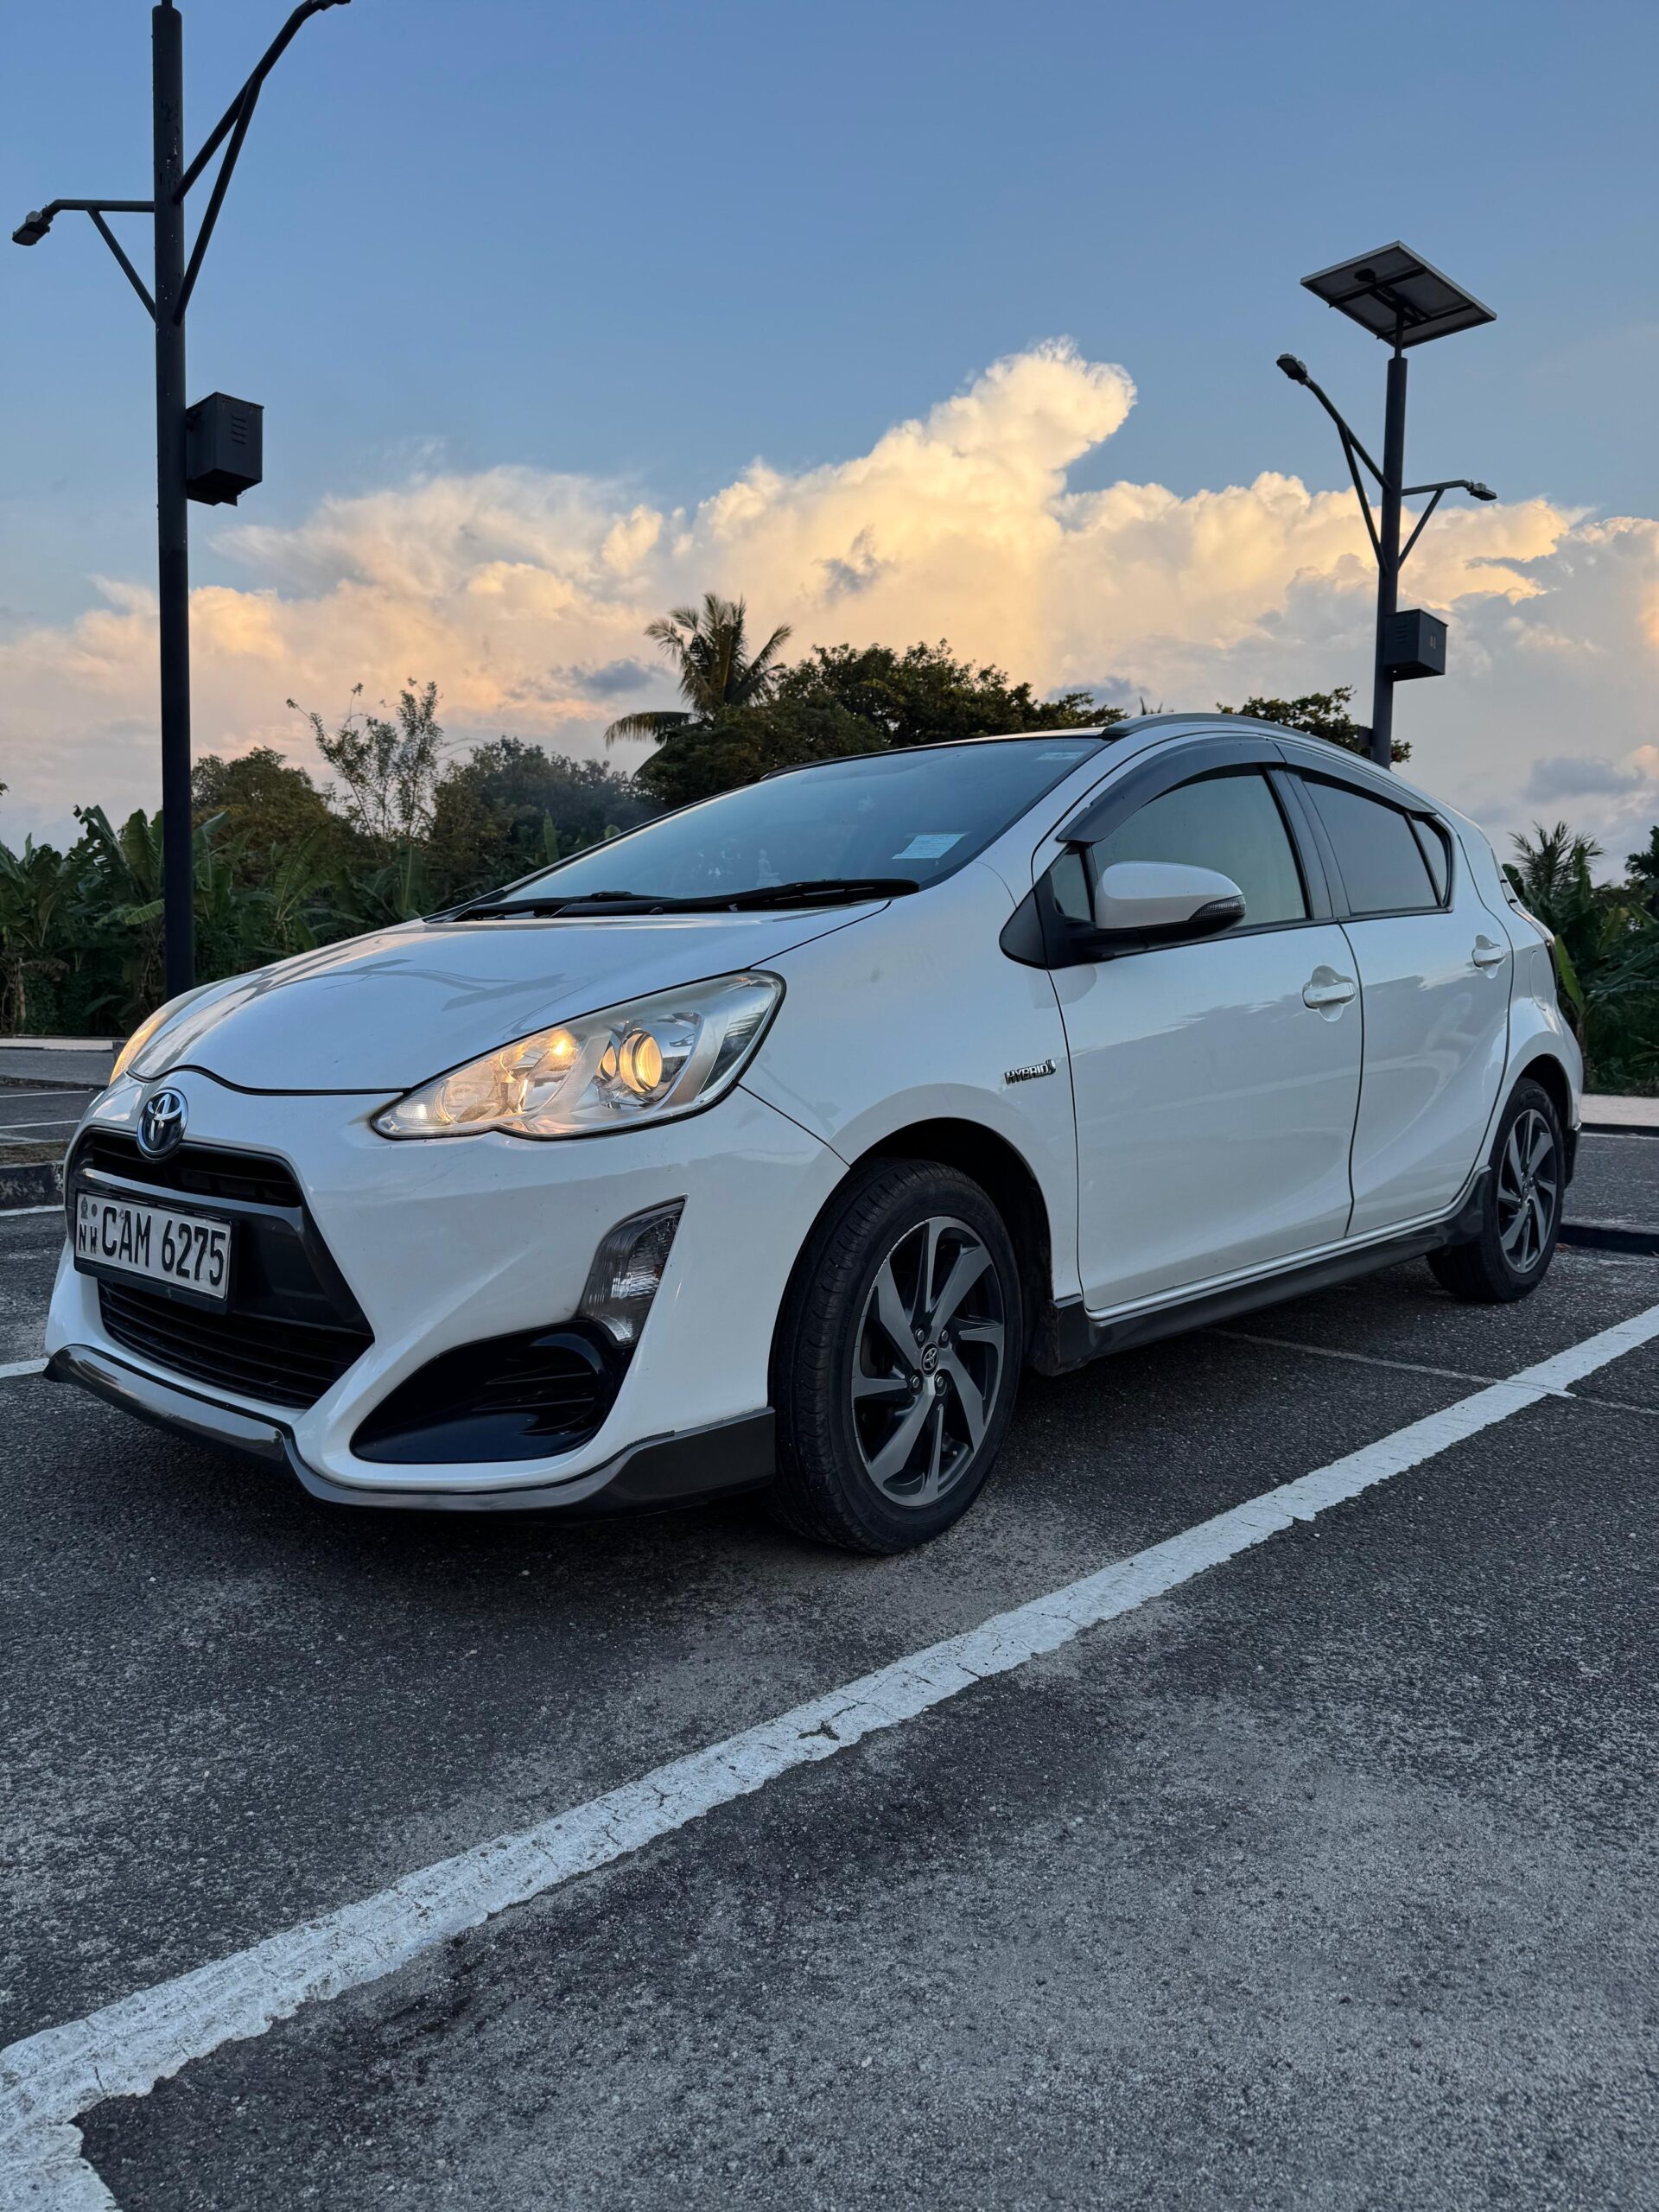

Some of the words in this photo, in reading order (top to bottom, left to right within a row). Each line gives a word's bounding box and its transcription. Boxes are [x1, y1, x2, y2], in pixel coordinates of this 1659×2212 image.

[1004, 1063, 1050, 1084] HYBRID
[101, 1206, 152, 1268] CAM
[161, 1219, 226, 1287] 6275
